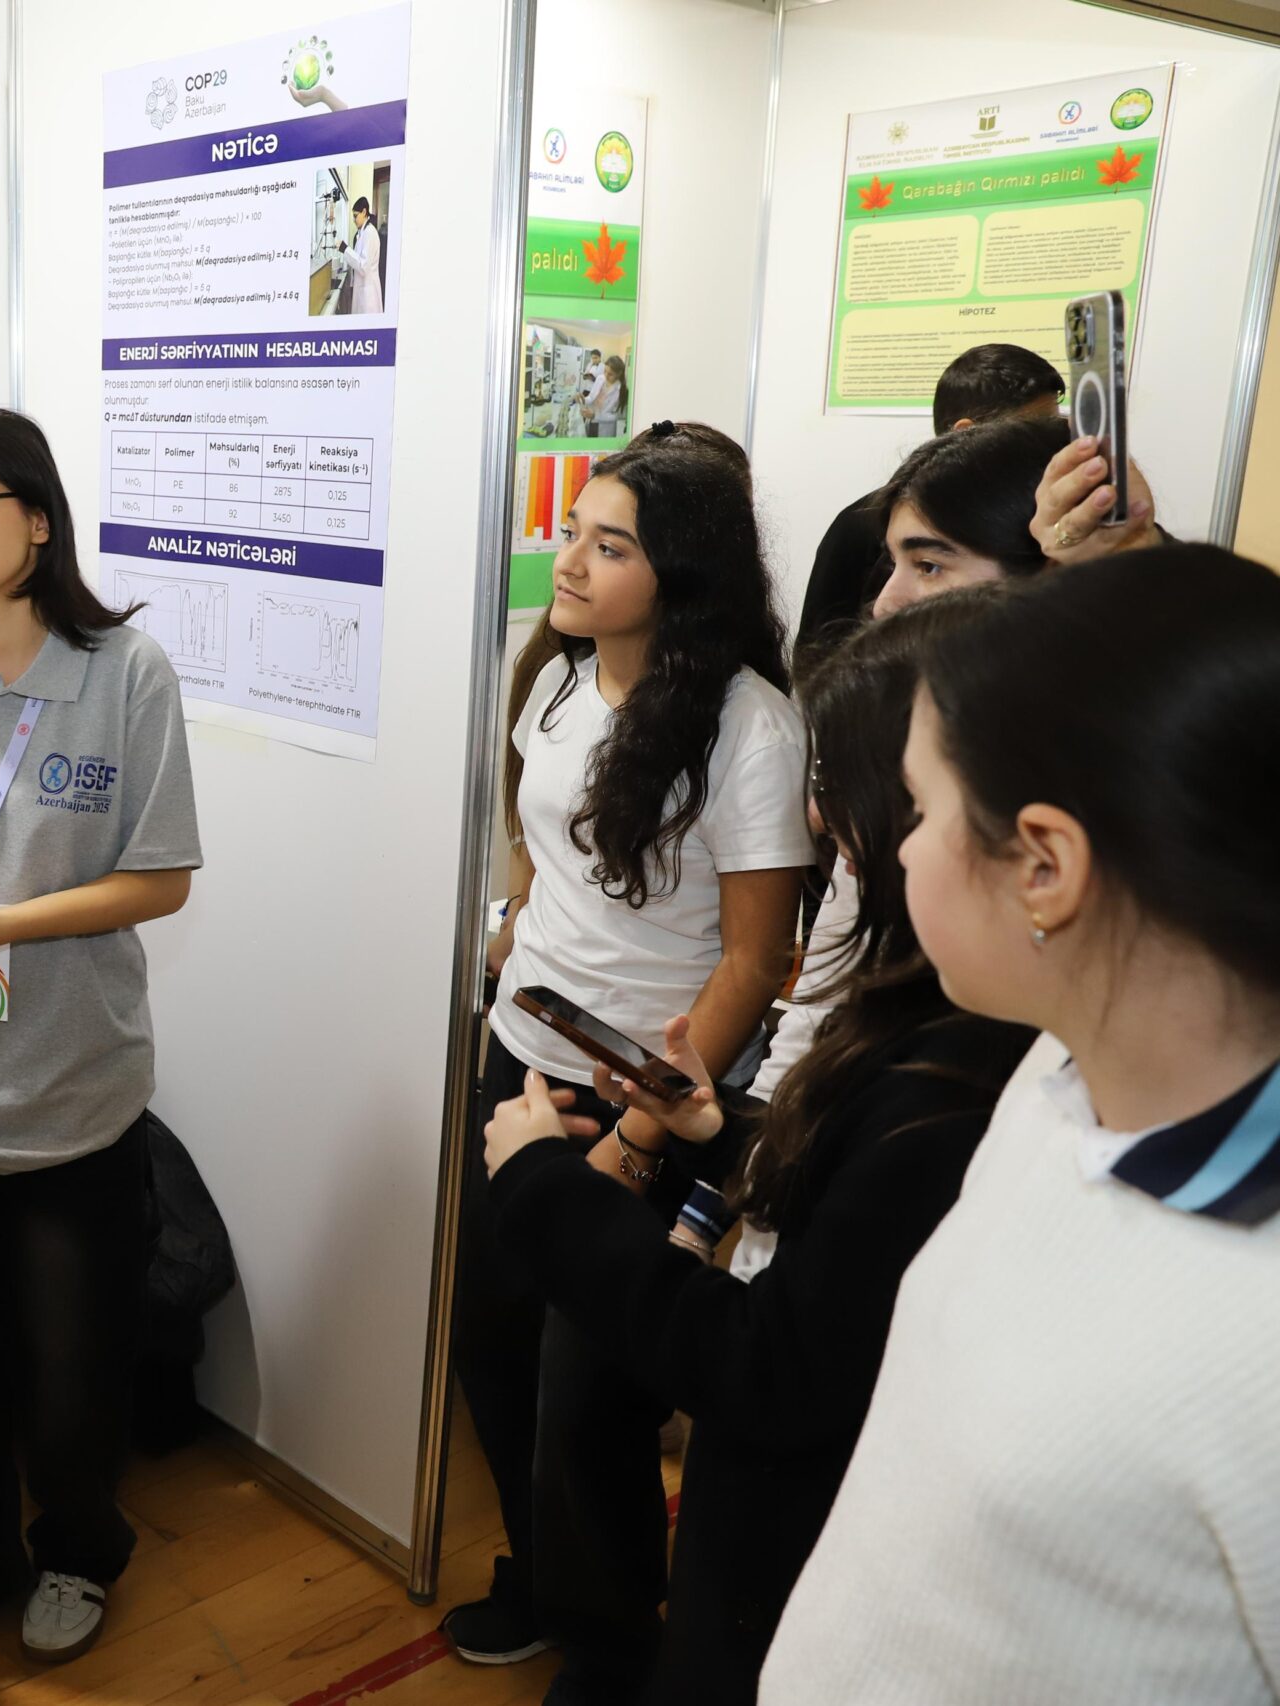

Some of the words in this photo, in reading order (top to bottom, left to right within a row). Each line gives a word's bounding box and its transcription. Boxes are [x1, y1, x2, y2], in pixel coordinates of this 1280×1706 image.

[185, 69, 228, 92] COP29
[185, 95, 205, 107] Baku
[184, 103, 227, 119] Azerbaijan
[976, 104, 1001, 116] ARTİ
[211, 132, 278, 162] NƏTİCƏ
[902, 180, 976, 199] Qarabağın
[981, 174, 1036, 191] Qırmızı
[1041, 166, 1085, 186] palıdı
[109, 204, 131, 213] Polimer
[174, 192, 214, 205] deqradasiya
[215, 185, 261, 200] məhsuldarlığı
[262, 180, 297, 194] aşağıdakı
[282, 249, 293, 259] 4.3
[531, 248, 578, 274] palıdı
[282, 291, 293, 300] 4.6
[959, 306, 996, 316] HİPOTEZ
[119, 343, 158, 361] ENERJİ
[160, 341, 258, 360] SƏRFİYYATININ
[266, 340, 378, 358] HESABLANMASI
[104, 379, 129, 389] Proses
[130, 380, 157, 389] zamanı
[158, 378, 172, 389] sərf
[174, 378, 204, 389] olunan
[205, 377, 230, 391] enerji
[232, 377, 253, 389] istilik
[255, 377, 298, 389] balansına
[301, 379, 334, 389] əsasən
[337, 378, 360, 391] təyin
[104, 412, 111, 423] Q
[140, 412, 192, 423] düsturundan
[229, 414, 269, 427] etmişəm.
[117, 446, 150, 456] Katalizator
[165, 448, 195, 458] Polimer
[209, 442, 259, 454] Məhsuldarlıq
[273, 444, 296, 456] Enerji
[320, 446, 358, 458] Reaksiya
[228, 457, 240, 468] (%)
[266, 460, 302, 473] sərfiyyatı
[309, 462, 350, 474] kinetikası
[173, 480, 183, 490] PE
[229, 484, 238, 493] 86
[274, 487, 292, 497] 2875
[172, 505, 183, 514] PP
[228, 509, 237, 518] 92
[273, 513, 291, 524] 3450
[148, 535, 202, 557] ANALİZ
[206, 539, 297, 566] NƏTİCƏLƏRİ
[211, 680, 225, 690] FTIR
[248, 687, 345, 716] Polyethylene-terephthalate
[346, 709, 361, 719] FTIR
[74, 763, 117, 791] ISEF
[35, 795, 91, 814] Azerbaijan
[92, 802, 110, 814] 2025
